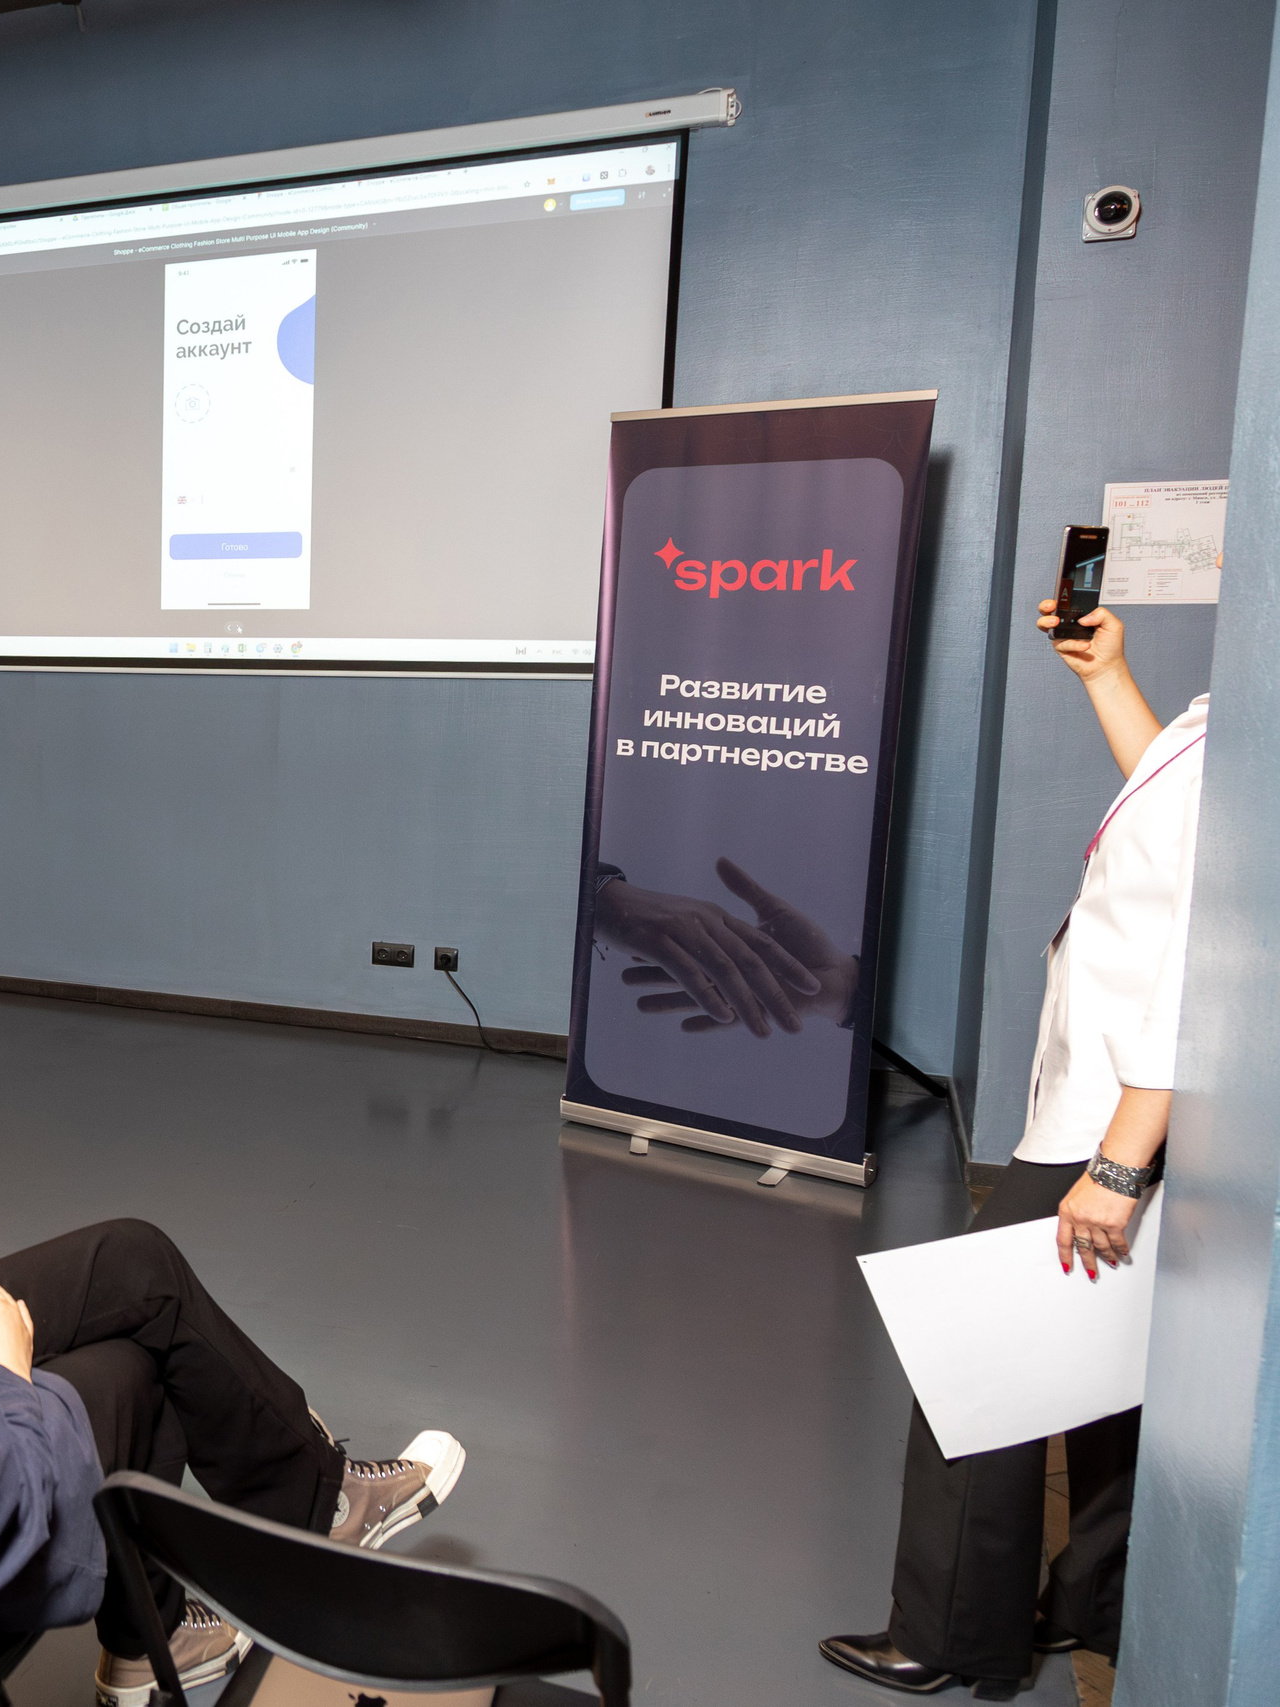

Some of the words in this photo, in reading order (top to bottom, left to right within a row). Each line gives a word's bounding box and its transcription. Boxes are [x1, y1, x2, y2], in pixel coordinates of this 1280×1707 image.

[114, 248, 134, 256] Shoppe
[138, 244, 170, 253] eCommerce
[171, 241, 193, 250] Clothing
[194, 239, 215, 247] Fashion
[215, 237, 231, 245] Store
[231, 235, 245, 243] Multi
[245, 233, 269, 242] Purpose
[277, 230, 297, 238] Mobile
[297, 229, 309, 237] App
[310, 227, 330, 235] Design
[331, 222, 369, 233] (Community)
[176, 314, 246, 335] Создай
[176, 341, 252, 360] аккаунт
[221, 543, 249, 551] Готово
[674, 549, 858, 599] spark
[660, 674, 827, 704] Развитие
[643, 709, 841, 739] инноваций
[616, 739, 635, 756] в
[641, 740, 869, 774] партнерстве
